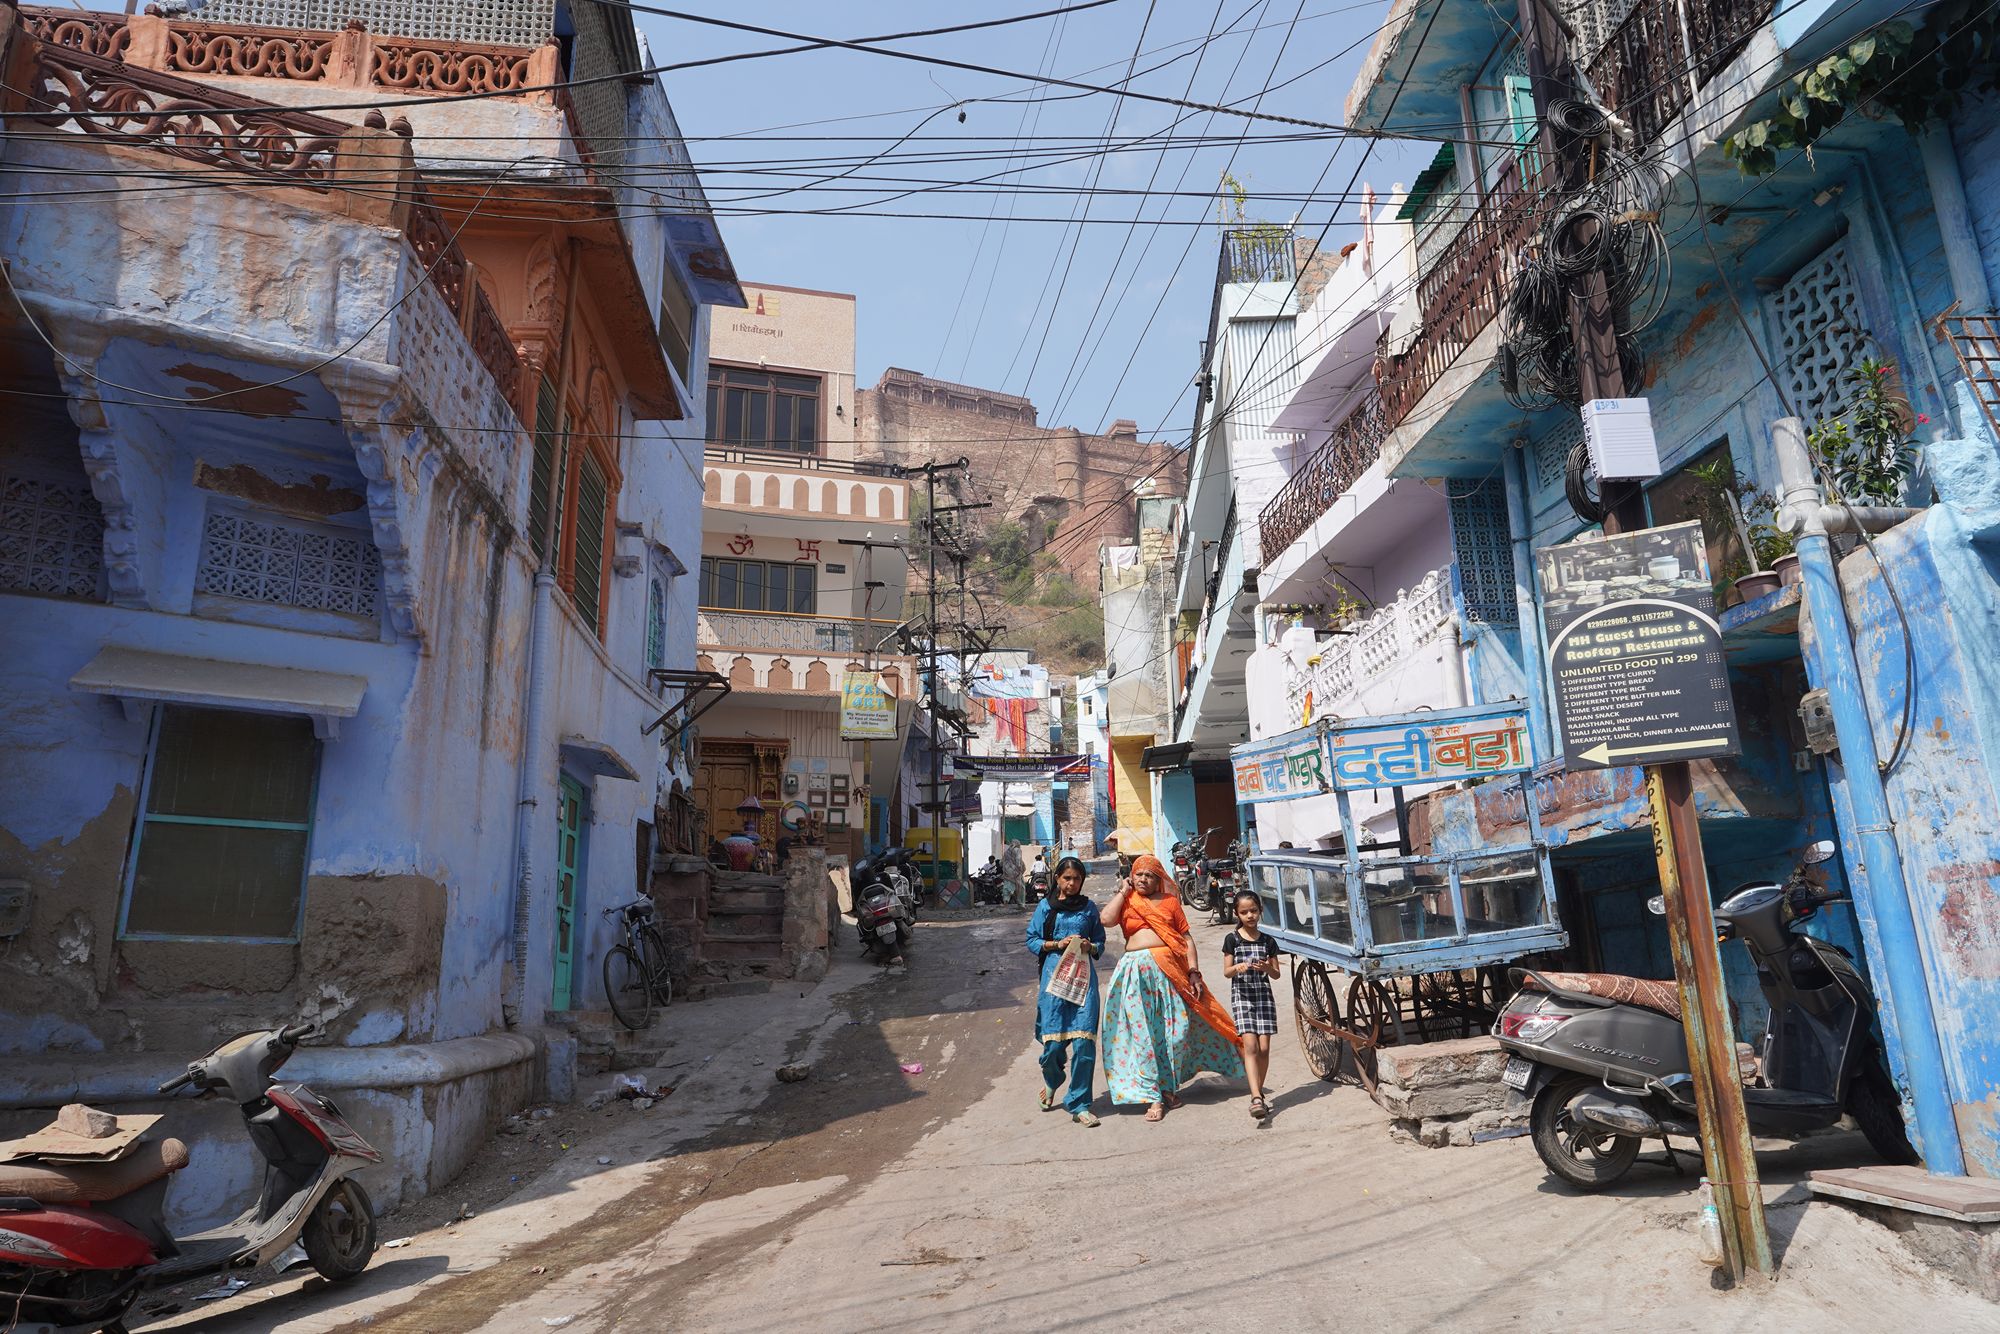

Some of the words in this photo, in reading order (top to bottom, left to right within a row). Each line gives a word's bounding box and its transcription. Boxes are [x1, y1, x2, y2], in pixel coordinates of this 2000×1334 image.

[1568, 635, 1591, 647] MH
[1595, 629, 1634, 643] Guest
[1639, 623, 1682, 637] House
[1687, 620, 1698, 631] &
[1566, 645, 1621, 660] Rooftop
[1625, 634, 1706, 653] Restaurant
[1560, 663, 1622, 678] UNLIMITED
[1625, 659, 1658, 670] FOOD
[1661, 656, 1674, 665] IN
[1676, 653, 1698, 663] 299
[1567, 675, 1606, 685] DIFFERENT
[1608, 673, 1626, 681] TYPE
[1627, 669, 1657, 678] CURRYS
[1568, 682, 1607, 693] DIFFERENT
[1609, 680, 1627, 688] TYPE
[1628, 677, 1654, 685] BREAD
[1569, 690, 1608, 700] DIFFERENT
[1610, 687, 1628, 695] TYPE
[1629, 685, 1646, 693] RICE
[1570, 697, 1610, 707] DIFFERENT
[1611, 695, 1630, 703] TYPE
[1630, 690, 1660, 700] BUTTER
[1661, 689, 1681, 697] MILK
[1591, 704, 1614, 712] SERVE
[1616, 701, 1644, 709] DESERT
[1566, 714, 1594, 723] INDIAN
[1594, 711, 1620, 719] SNACK
[1567, 719, 1615, 730] RAJASTHANI,
[1616, 715, 1644, 724] INDIAN
[1660, 711, 1679, 719] TYPE
[1570, 734, 1612, 745] BREAKFAST,
[1613, 731, 1642, 740] LUNCH,
[1643, 728, 1673, 737] DINNER
[1689, 722, 1731, 732] AVAILABLE
[1591, 725, 1631, 734] AVAILABLE
[1334, 727, 1431, 785] दही
